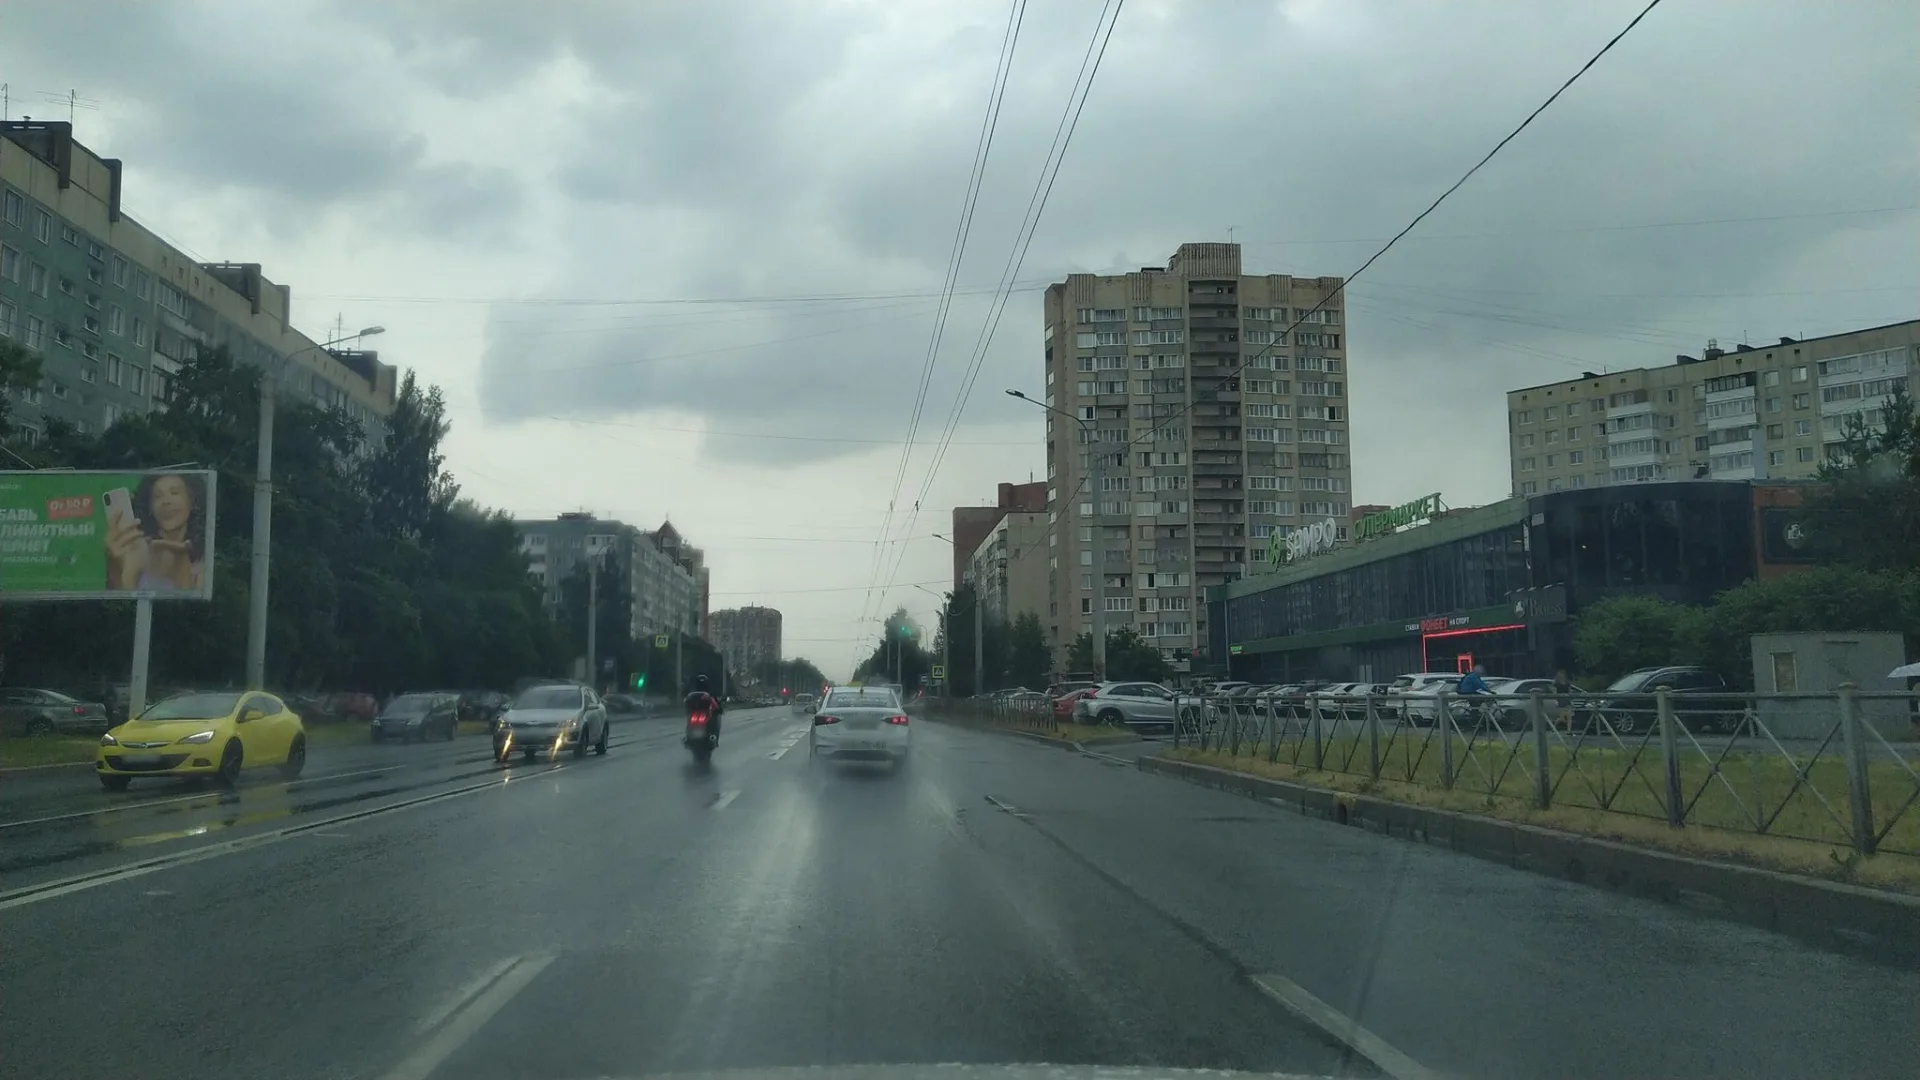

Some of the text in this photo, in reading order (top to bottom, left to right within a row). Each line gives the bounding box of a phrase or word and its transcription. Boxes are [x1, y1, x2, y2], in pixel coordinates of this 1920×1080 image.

[1354, 492, 1441, 540] СУПЕРМАРКЕТ
[1286, 517, 1337, 562] SAMPO
[1420, 617, 1448, 631] ФОНБЕТ
[1456, 616, 1470, 625] СПОРТ
